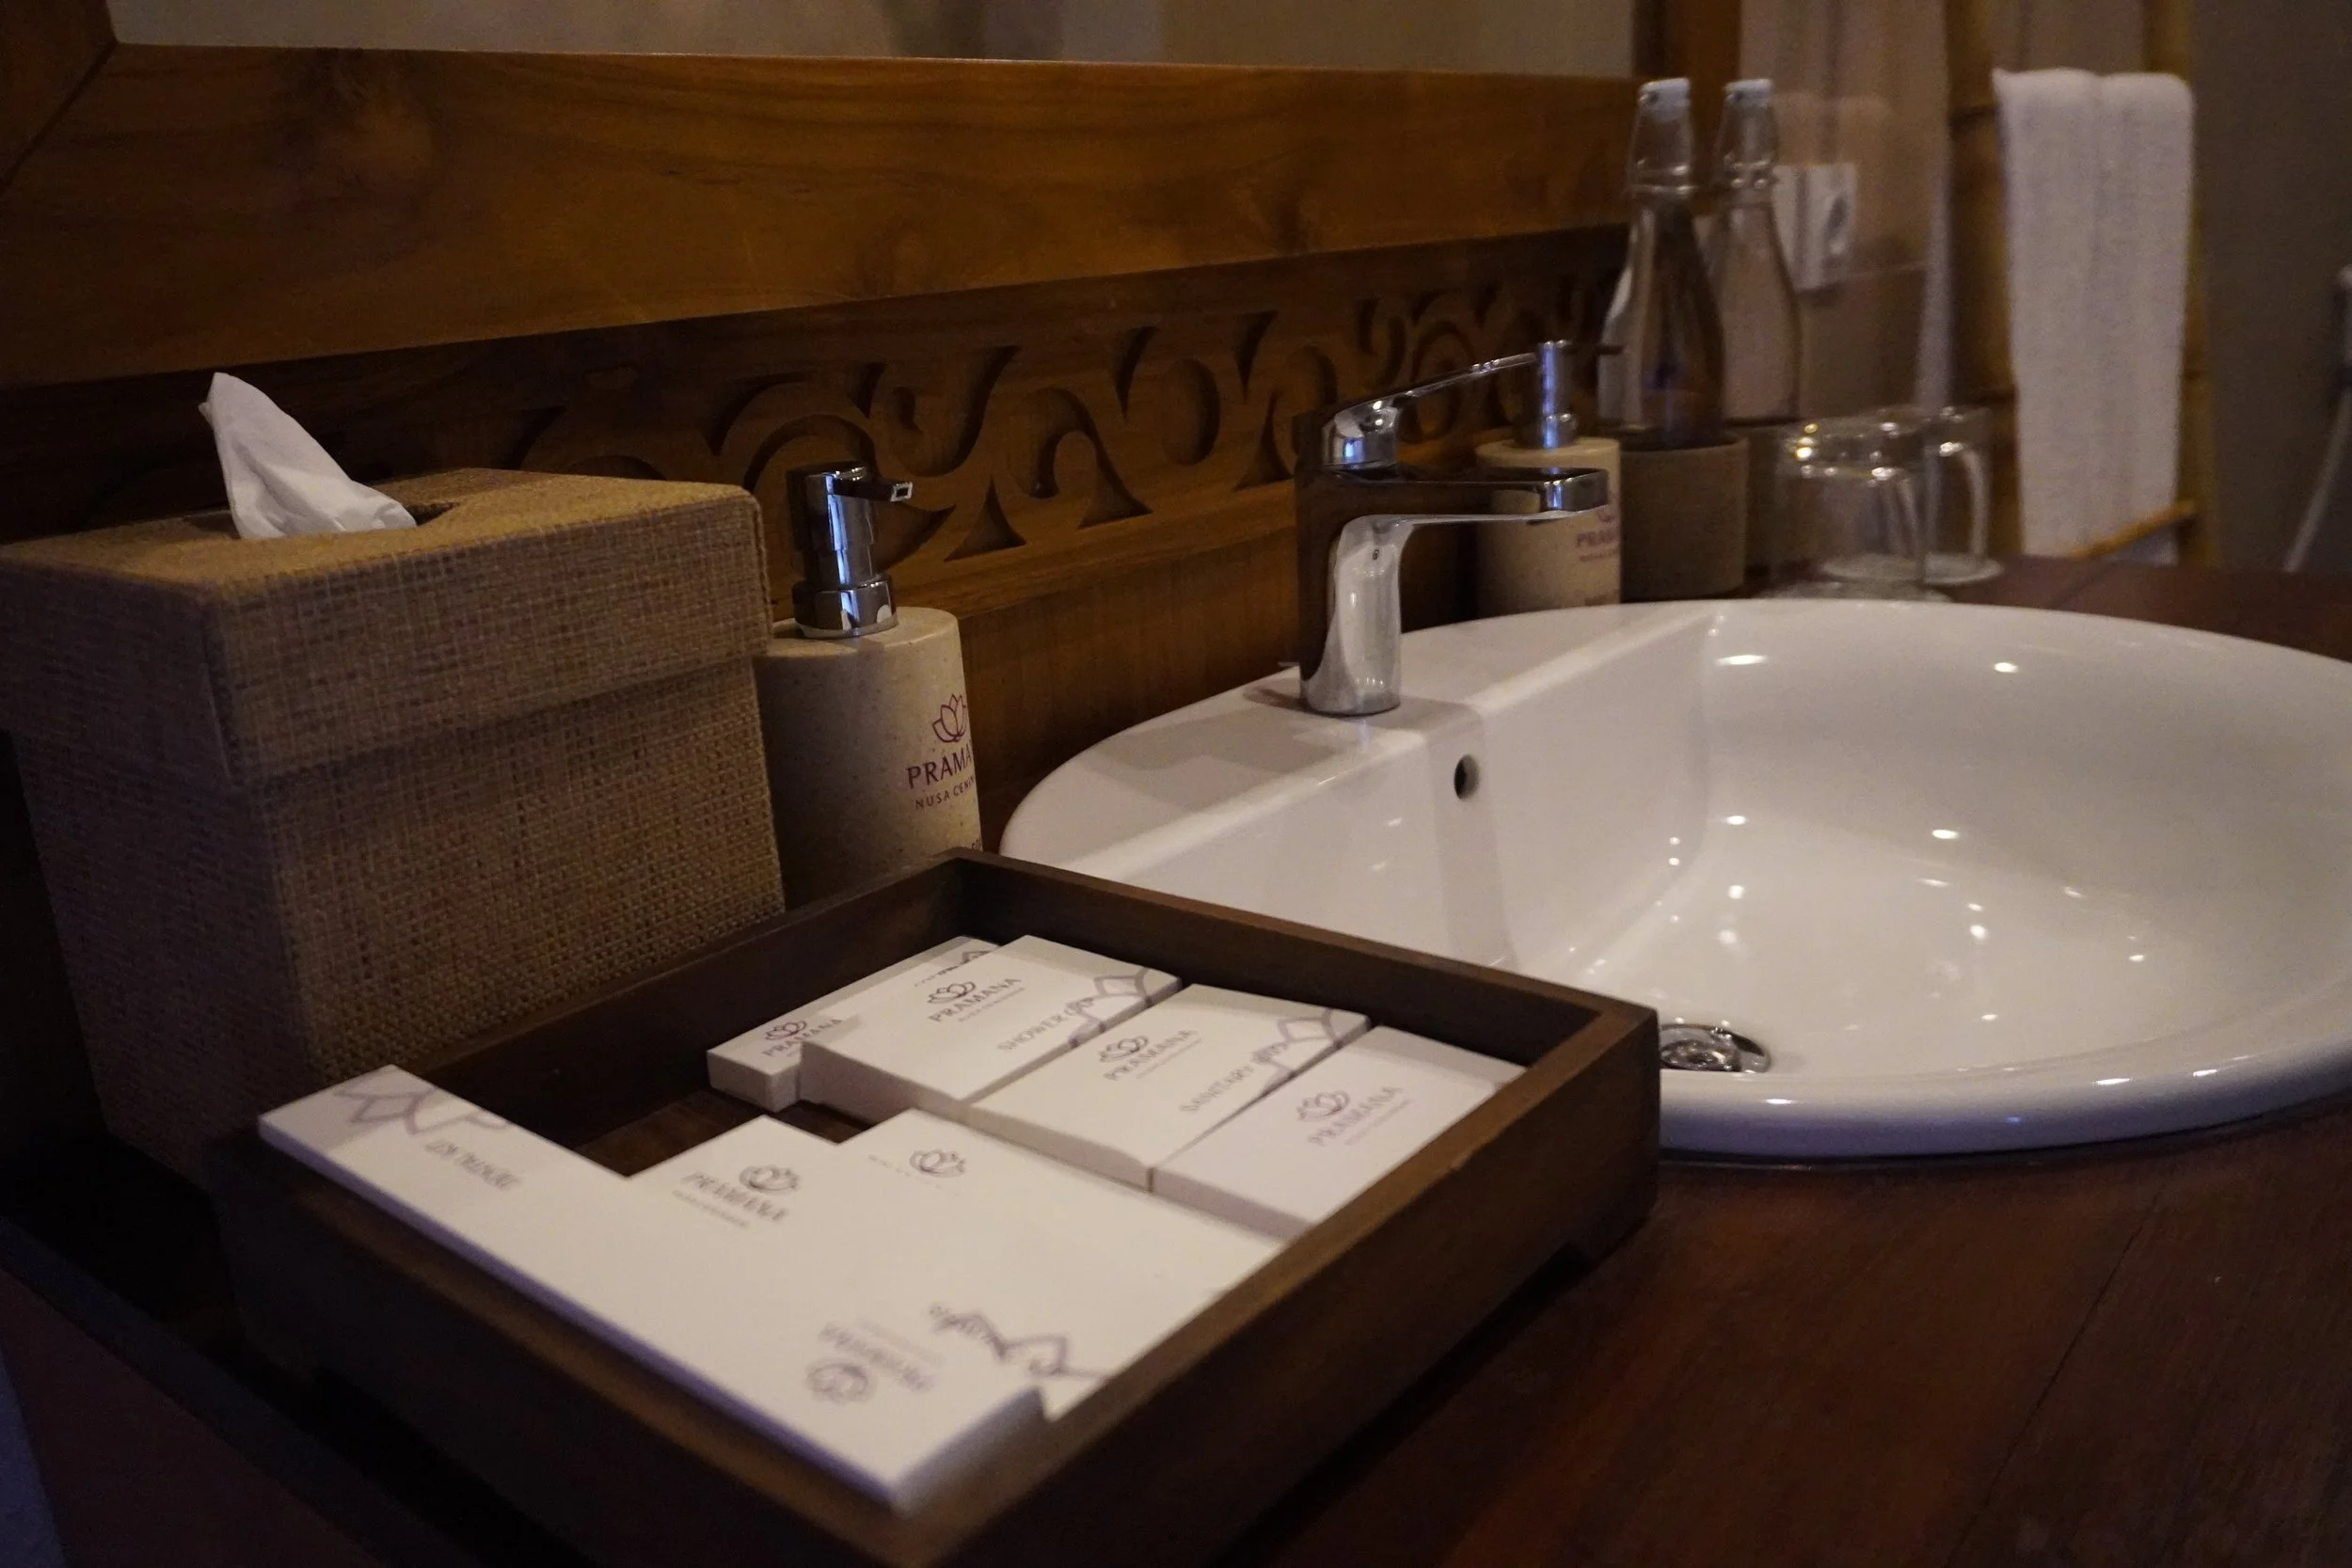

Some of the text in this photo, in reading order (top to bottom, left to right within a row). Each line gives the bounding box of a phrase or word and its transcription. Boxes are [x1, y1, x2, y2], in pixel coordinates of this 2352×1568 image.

[915, 791, 950, 809] NUSA
[928, 978, 1022, 1022] PRAMANA
[997, 1012, 1069, 1051] SHOWER
